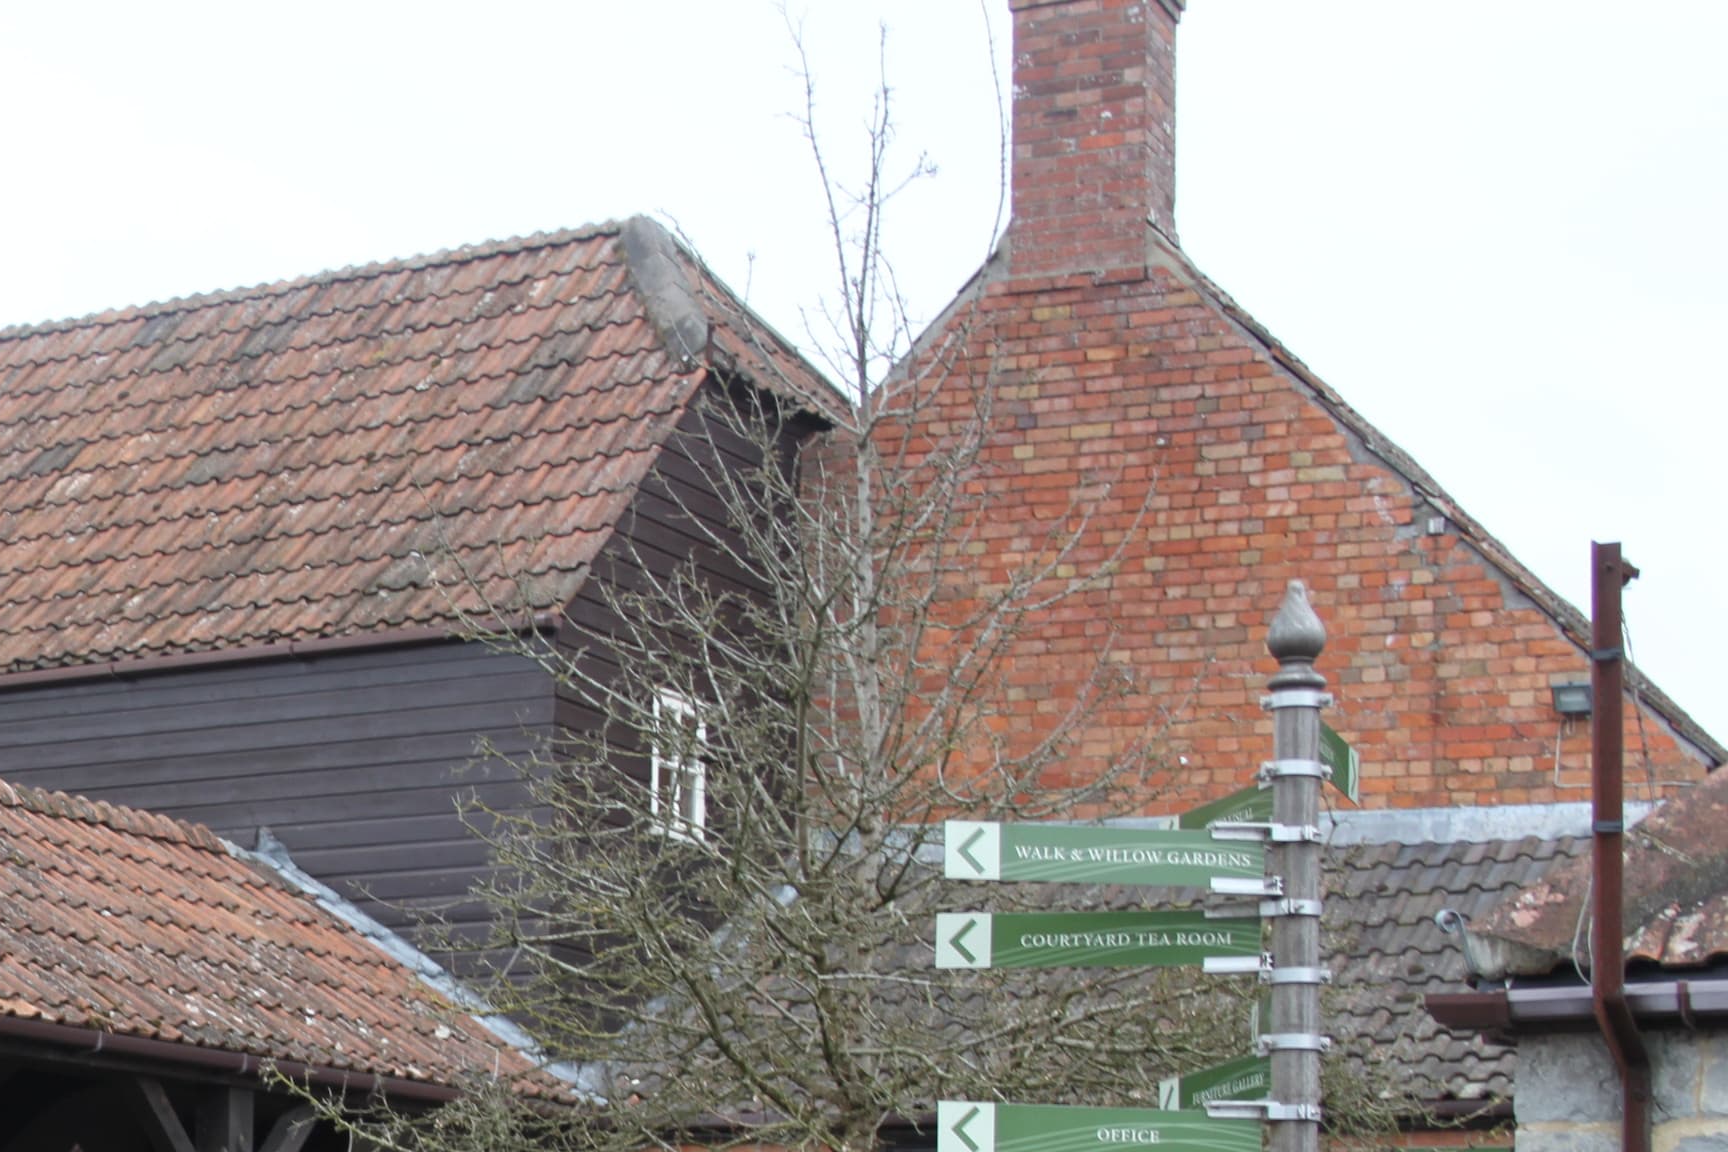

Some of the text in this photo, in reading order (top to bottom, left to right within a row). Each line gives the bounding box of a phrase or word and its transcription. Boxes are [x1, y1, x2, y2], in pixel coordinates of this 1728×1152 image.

[1015, 845, 1252, 867] WALK & WILLOW GARDENS
[1020, 931, 1232, 948] COURTYARD TEA ROOM
[1232, 1071, 1265, 1094] GALLERY
[1096, 1127, 1160, 1144] OFFICE
